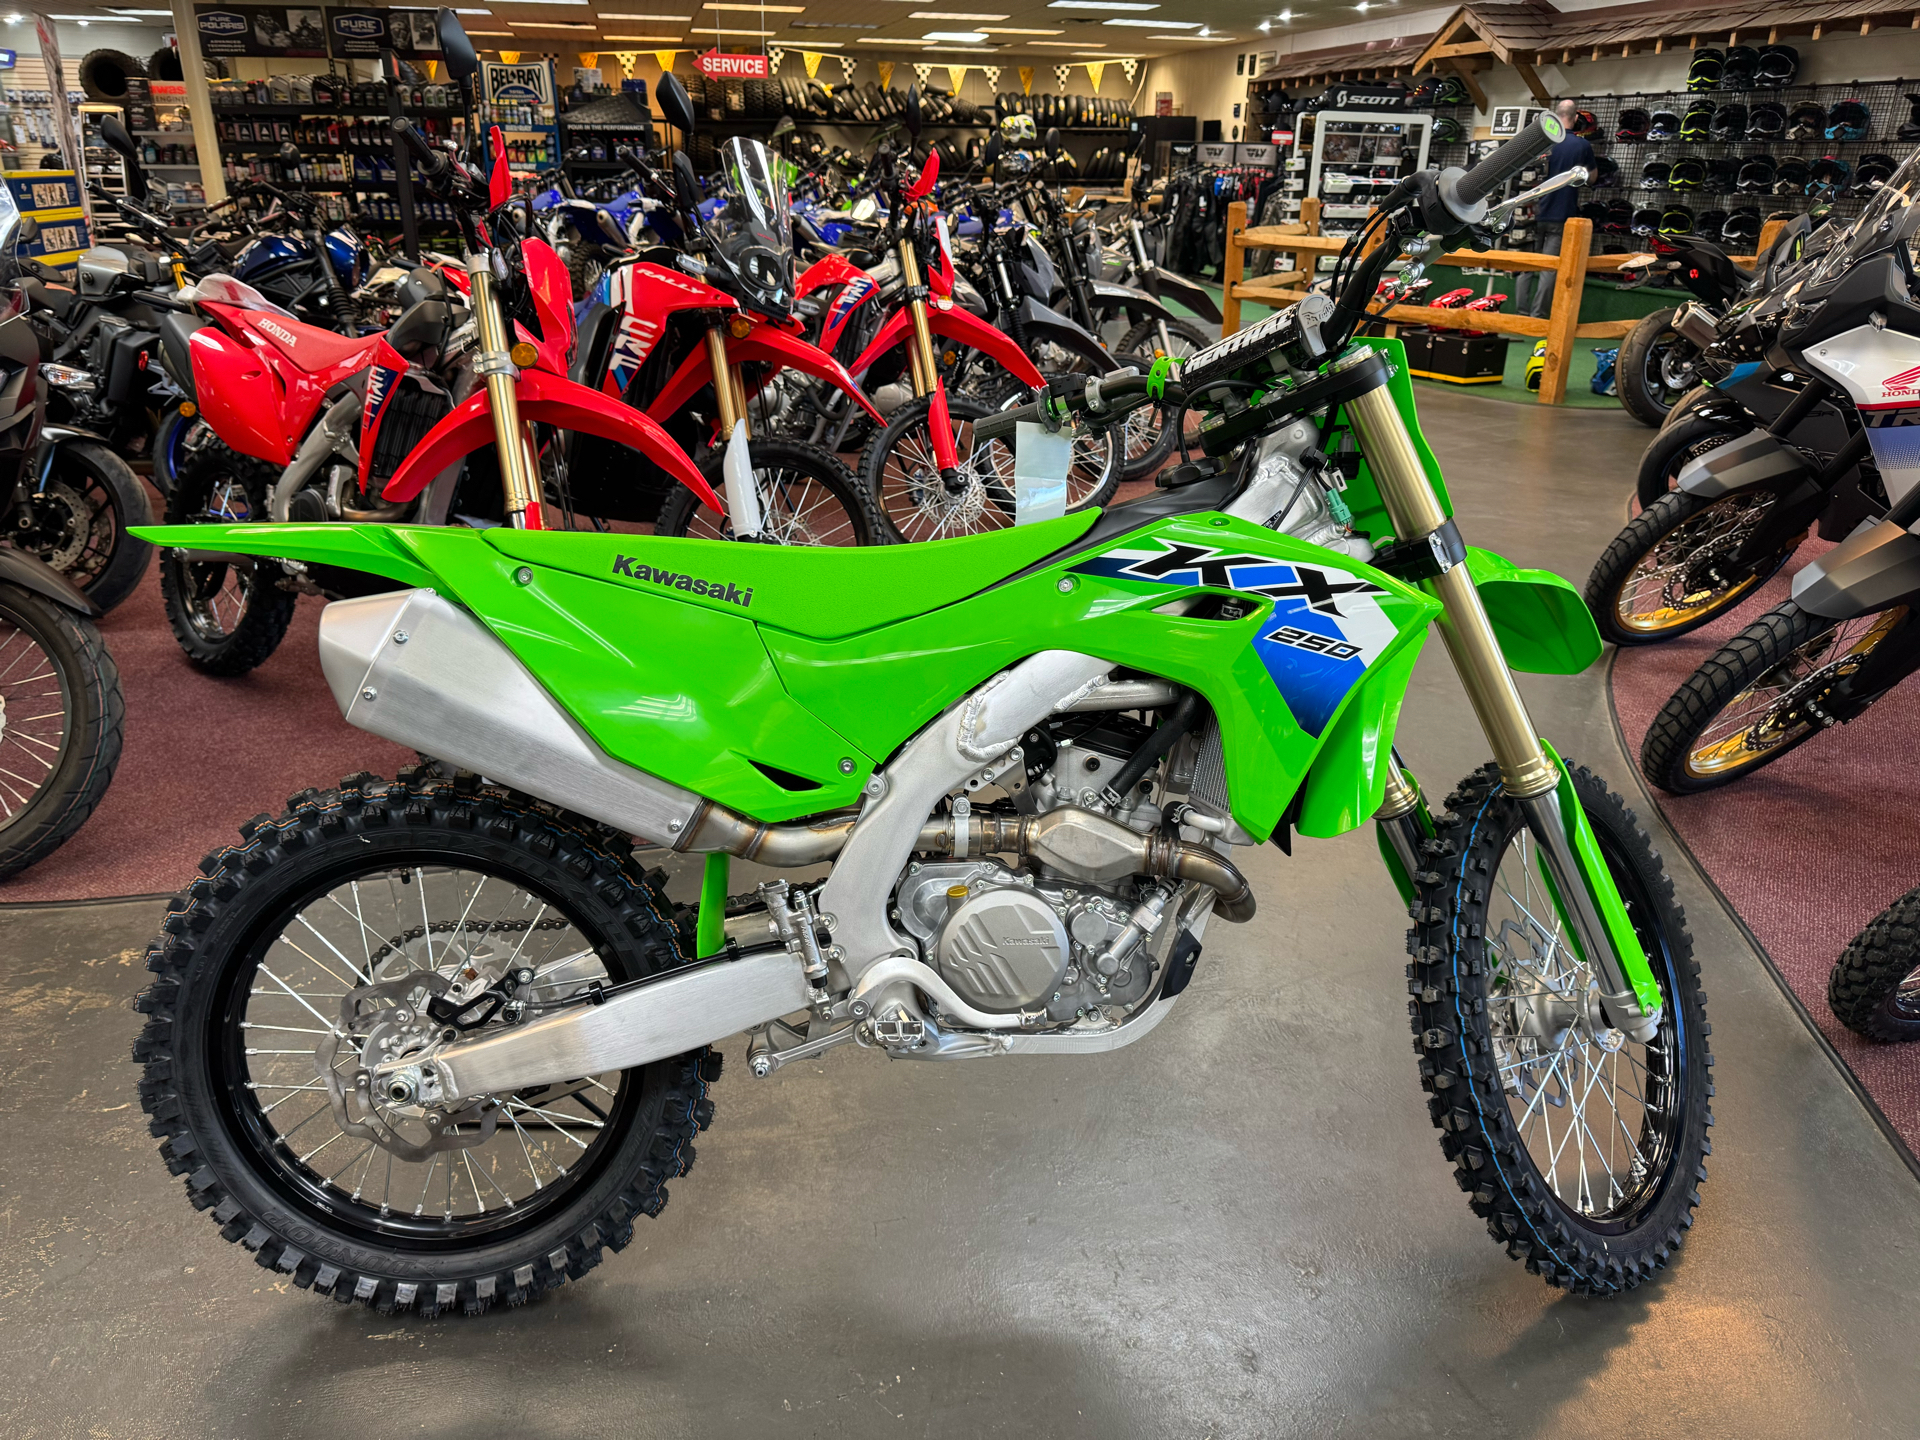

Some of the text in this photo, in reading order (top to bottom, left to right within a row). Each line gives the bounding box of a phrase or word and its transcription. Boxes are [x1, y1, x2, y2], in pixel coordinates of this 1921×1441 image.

[200, 21, 245, 30] POLARIS
[340, 20, 377, 29] PURE
[702, 57, 764, 75] SERVICE
[1347, 95, 1400, 105] SCOTT
[636, 268, 707, 295] RALLY
[257, 318, 298, 348] HONDA
[1184, 312, 1293, 376] RENTHAL
[1881, 389, 1920, 398] HOND
[611, 554, 754, 608] Kawasaki
[1122, 540, 1391, 619] KX
[1264, 625, 1363, 661] 250
[1002, 936, 1051, 947] Kawasaki
[261, 1211, 417, 1276] DUNLOP
